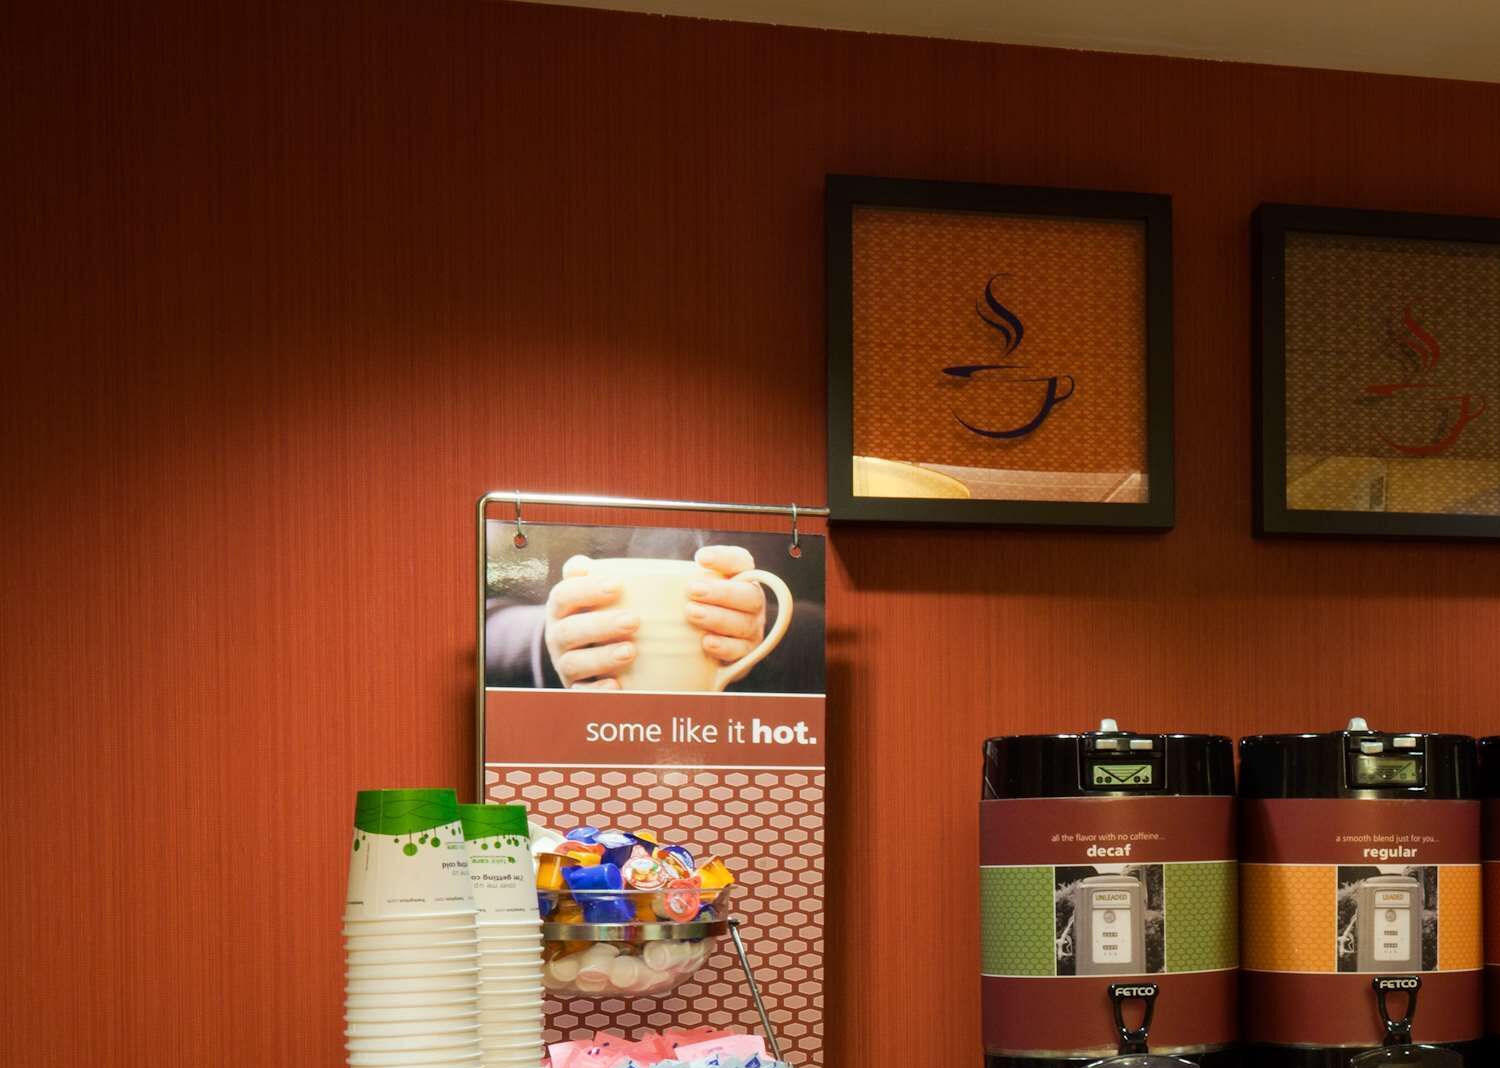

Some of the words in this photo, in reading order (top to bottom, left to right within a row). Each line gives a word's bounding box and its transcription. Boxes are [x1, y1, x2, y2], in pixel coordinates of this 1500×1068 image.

[585, 720, 662, 744] some
[671, 717, 718, 744] like
[727, 718, 745, 743] it
[751, 718, 817, 745] hot.
[1051, 834, 1060, 842] all
[1061, 833, 1074, 842] the
[1075, 832, 1097, 841] flavor
[1098, 831, 1117, 841] with
[1118, 832, 1129, 841] no
[1342, 834, 1371, 842] smooth
[1373, 833, 1395, 842] blend
[1396, 834, 1410, 844] just
[1411, 834, 1421, 842] for
[1086, 843, 1131, 857] decaf
[1363, 845, 1418, 861] regular
[482, 873, 513, 882] getting
[1379, 980, 1419, 989] FETCO
[1114, 986, 1156, 997] FETCO
